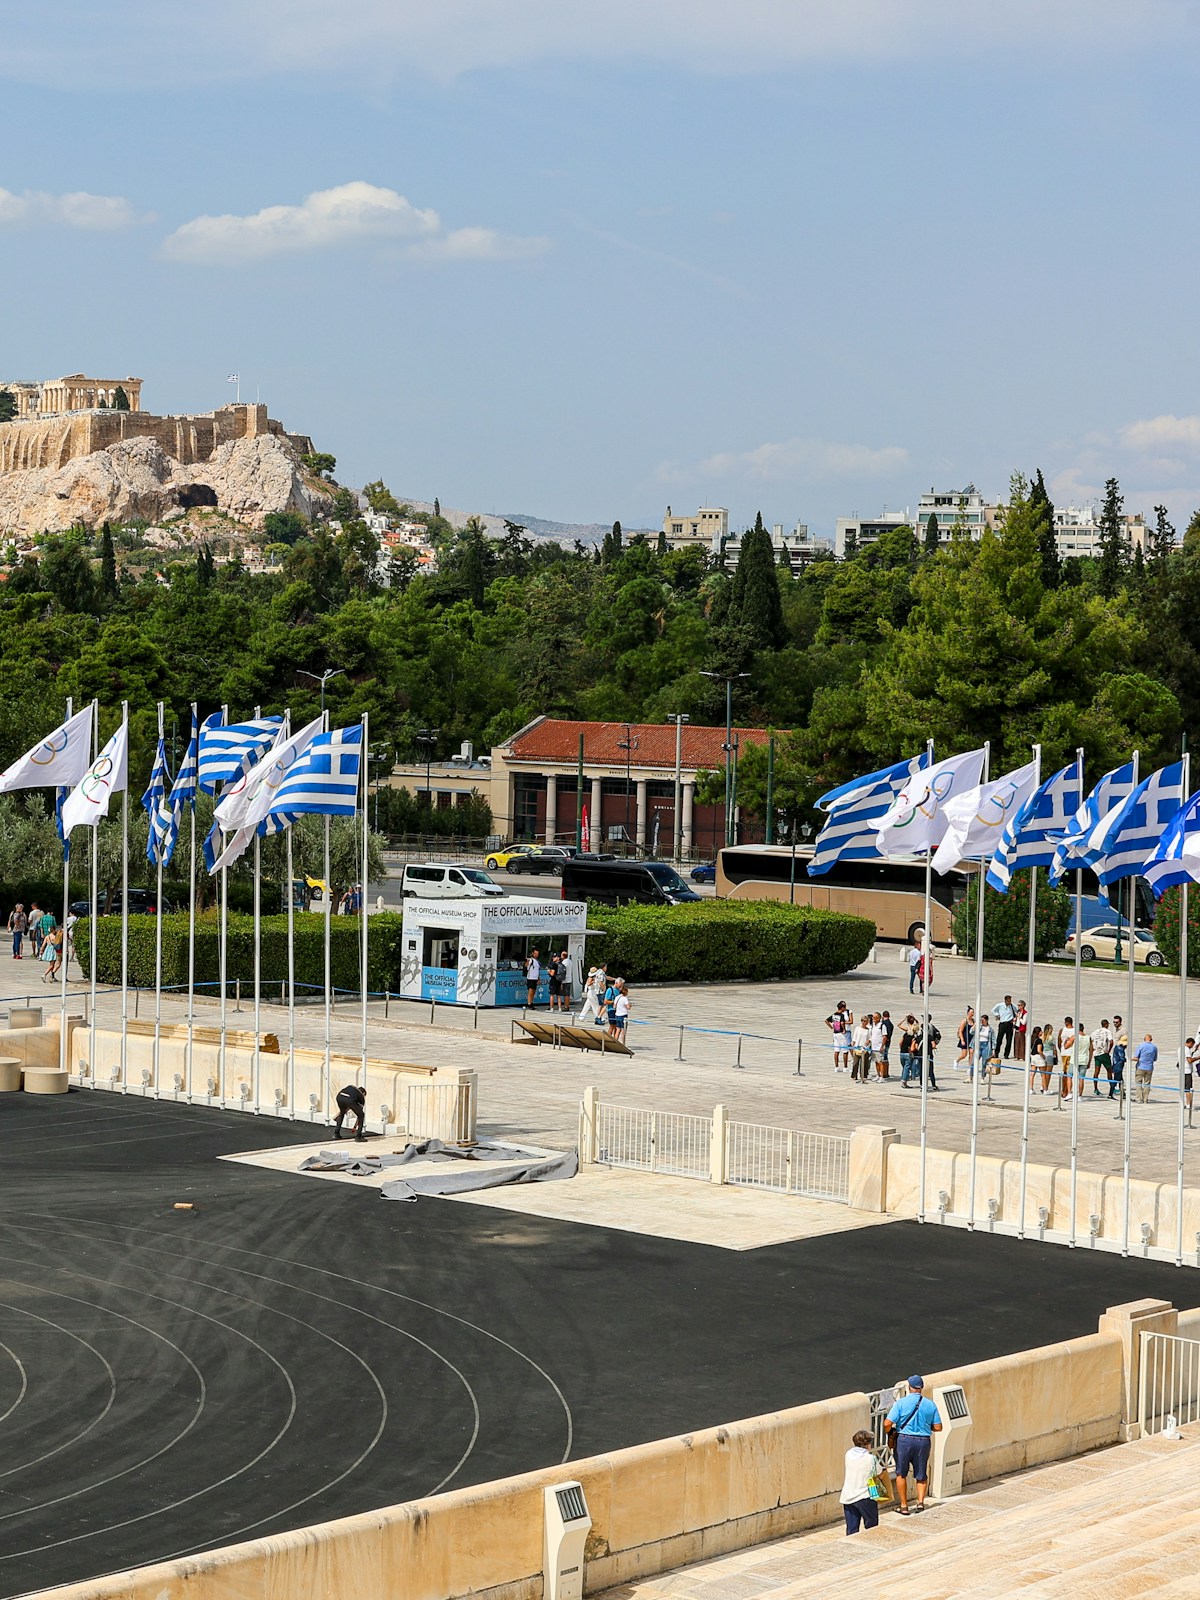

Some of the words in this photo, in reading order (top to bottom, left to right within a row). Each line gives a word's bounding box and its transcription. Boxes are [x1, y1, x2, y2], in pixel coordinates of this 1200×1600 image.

[418, 907, 440, 915] OFFICIAL
[441, 909, 462, 917] MUSEUM
[462, 911, 477, 919] SHOP
[483, 907, 498, 917] THE
[499, 906, 531, 917] OFFICIAL
[533, 906, 563, 916] MUSEUM
[564, 905, 584, 916] SHOP
[434, 974, 456, 982] OFFICIAL
[498, 980, 508, 988] THE
